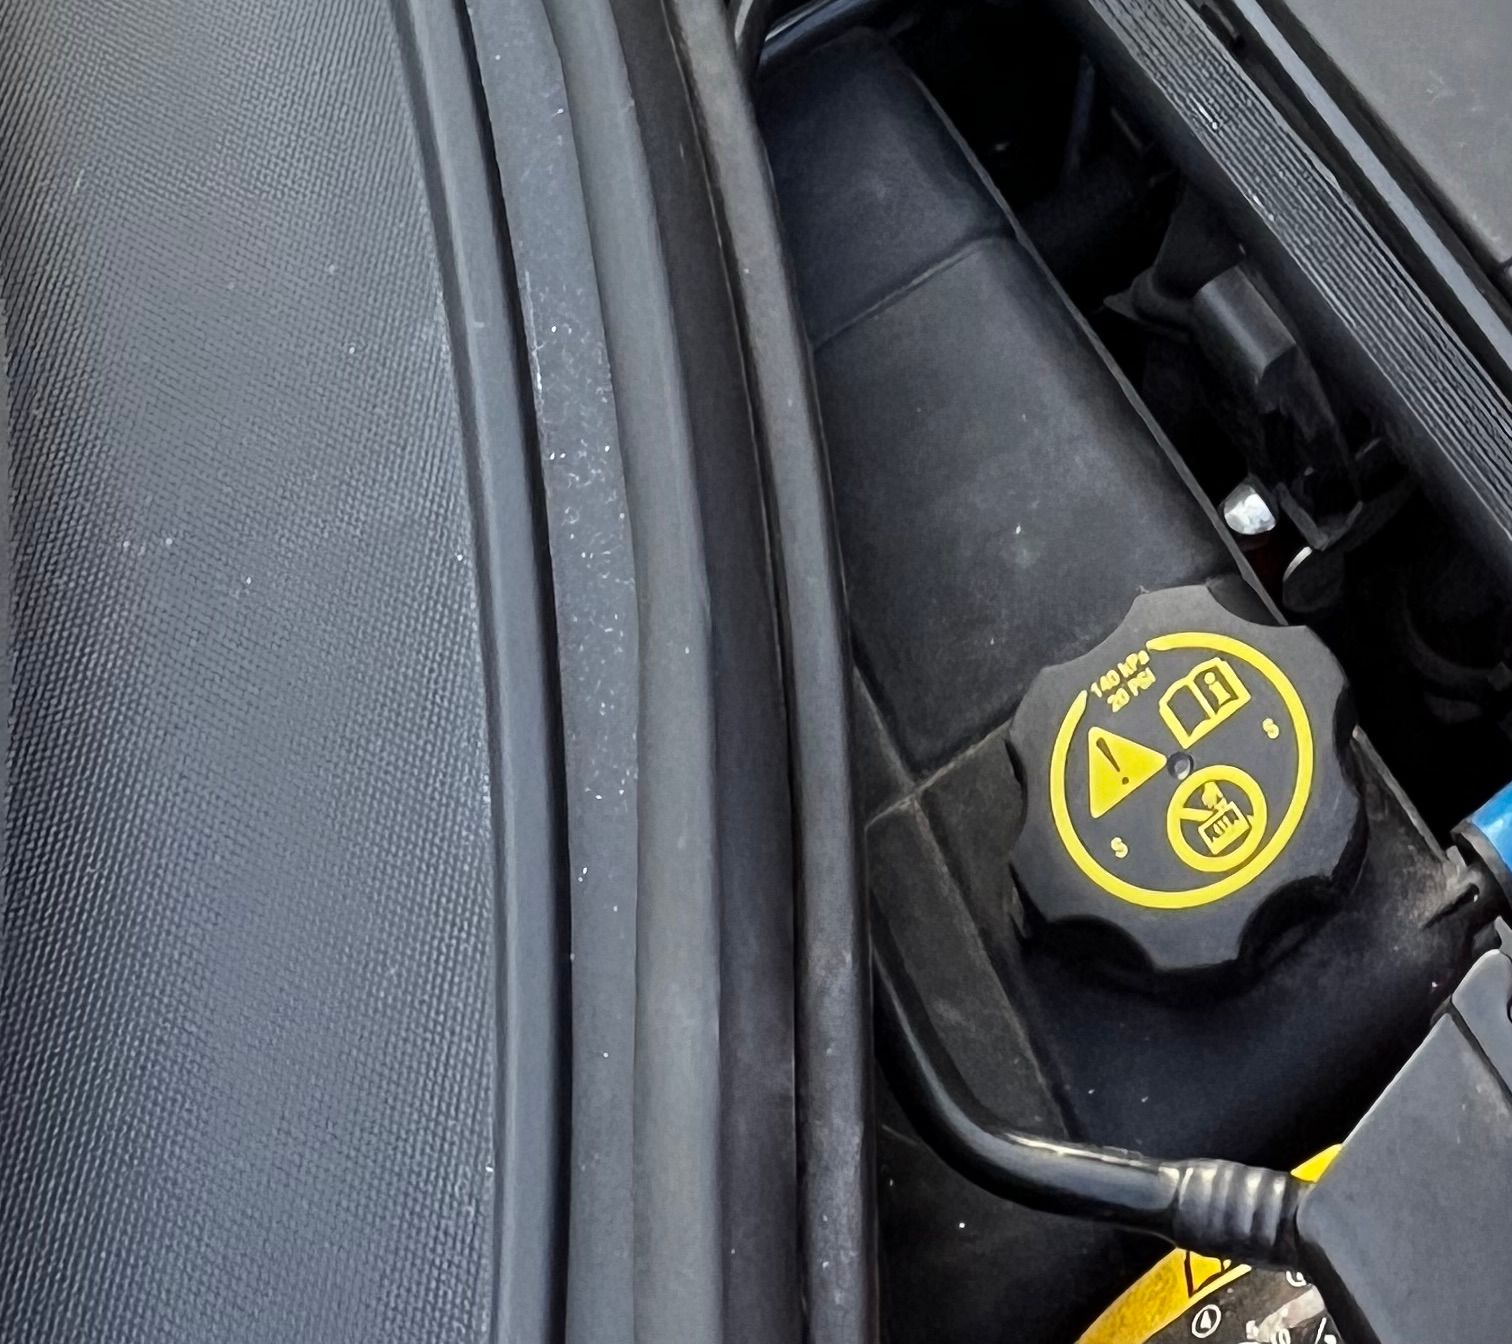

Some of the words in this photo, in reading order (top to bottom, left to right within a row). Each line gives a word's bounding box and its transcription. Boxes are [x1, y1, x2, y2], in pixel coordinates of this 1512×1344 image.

[1090, 669, 1121, 698] 140
[1107, 687, 1131, 713] 20
[1127, 667, 1156, 697] PSI
